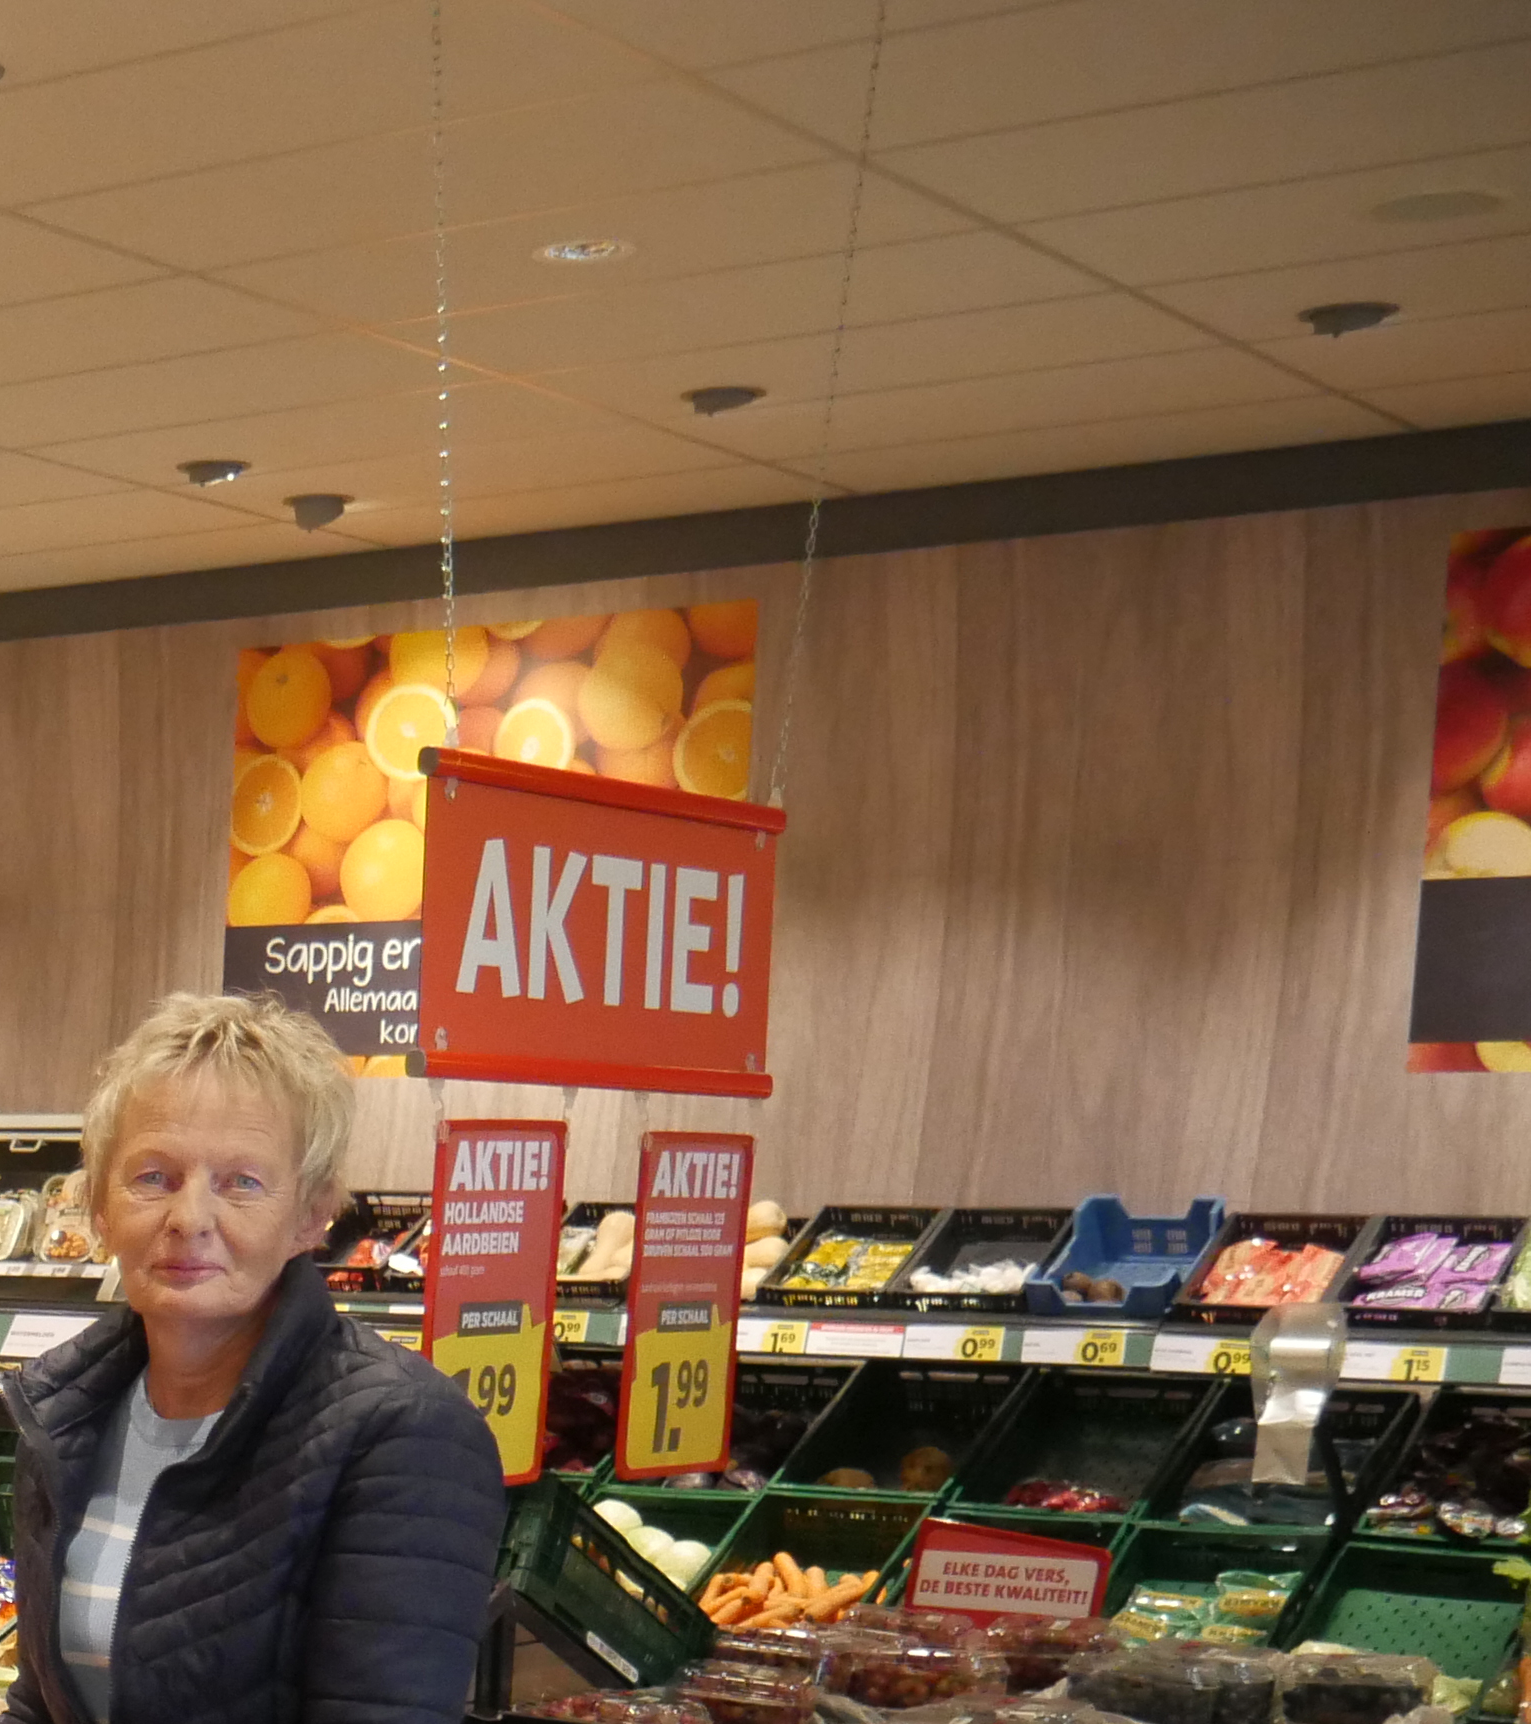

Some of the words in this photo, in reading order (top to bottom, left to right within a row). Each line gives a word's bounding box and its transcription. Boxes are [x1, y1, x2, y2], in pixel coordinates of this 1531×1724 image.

[455, 837, 744, 1018] AKTIE!
[264, 933, 374, 987] Sappig
[448, 1140, 552, 1192] AKTIE!
[651, 1150, 739, 1199] AKTIE!
[444, 1200, 524, 1225] HOLLANDSE
[441, 1231, 519, 1256] AARDBEIEN
[461, 1310, 479, 1329] PER
[480, 1308, 518, 1328] SCHAAL
[660, 1310, 674, 1325] PER
[675, 1308, 710, 1325] SCHAAL
[942, 1562, 980, 1576] ELKE
[984, 1564, 1019, 1580] DAG
[1024, 1567, 1070, 1586] VERS,
[919, 1579, 940, 1593] DE
[944, 1581, 990, 1597] BESTE
[994, 1585, 1088, 1605] KWALITEIT!
